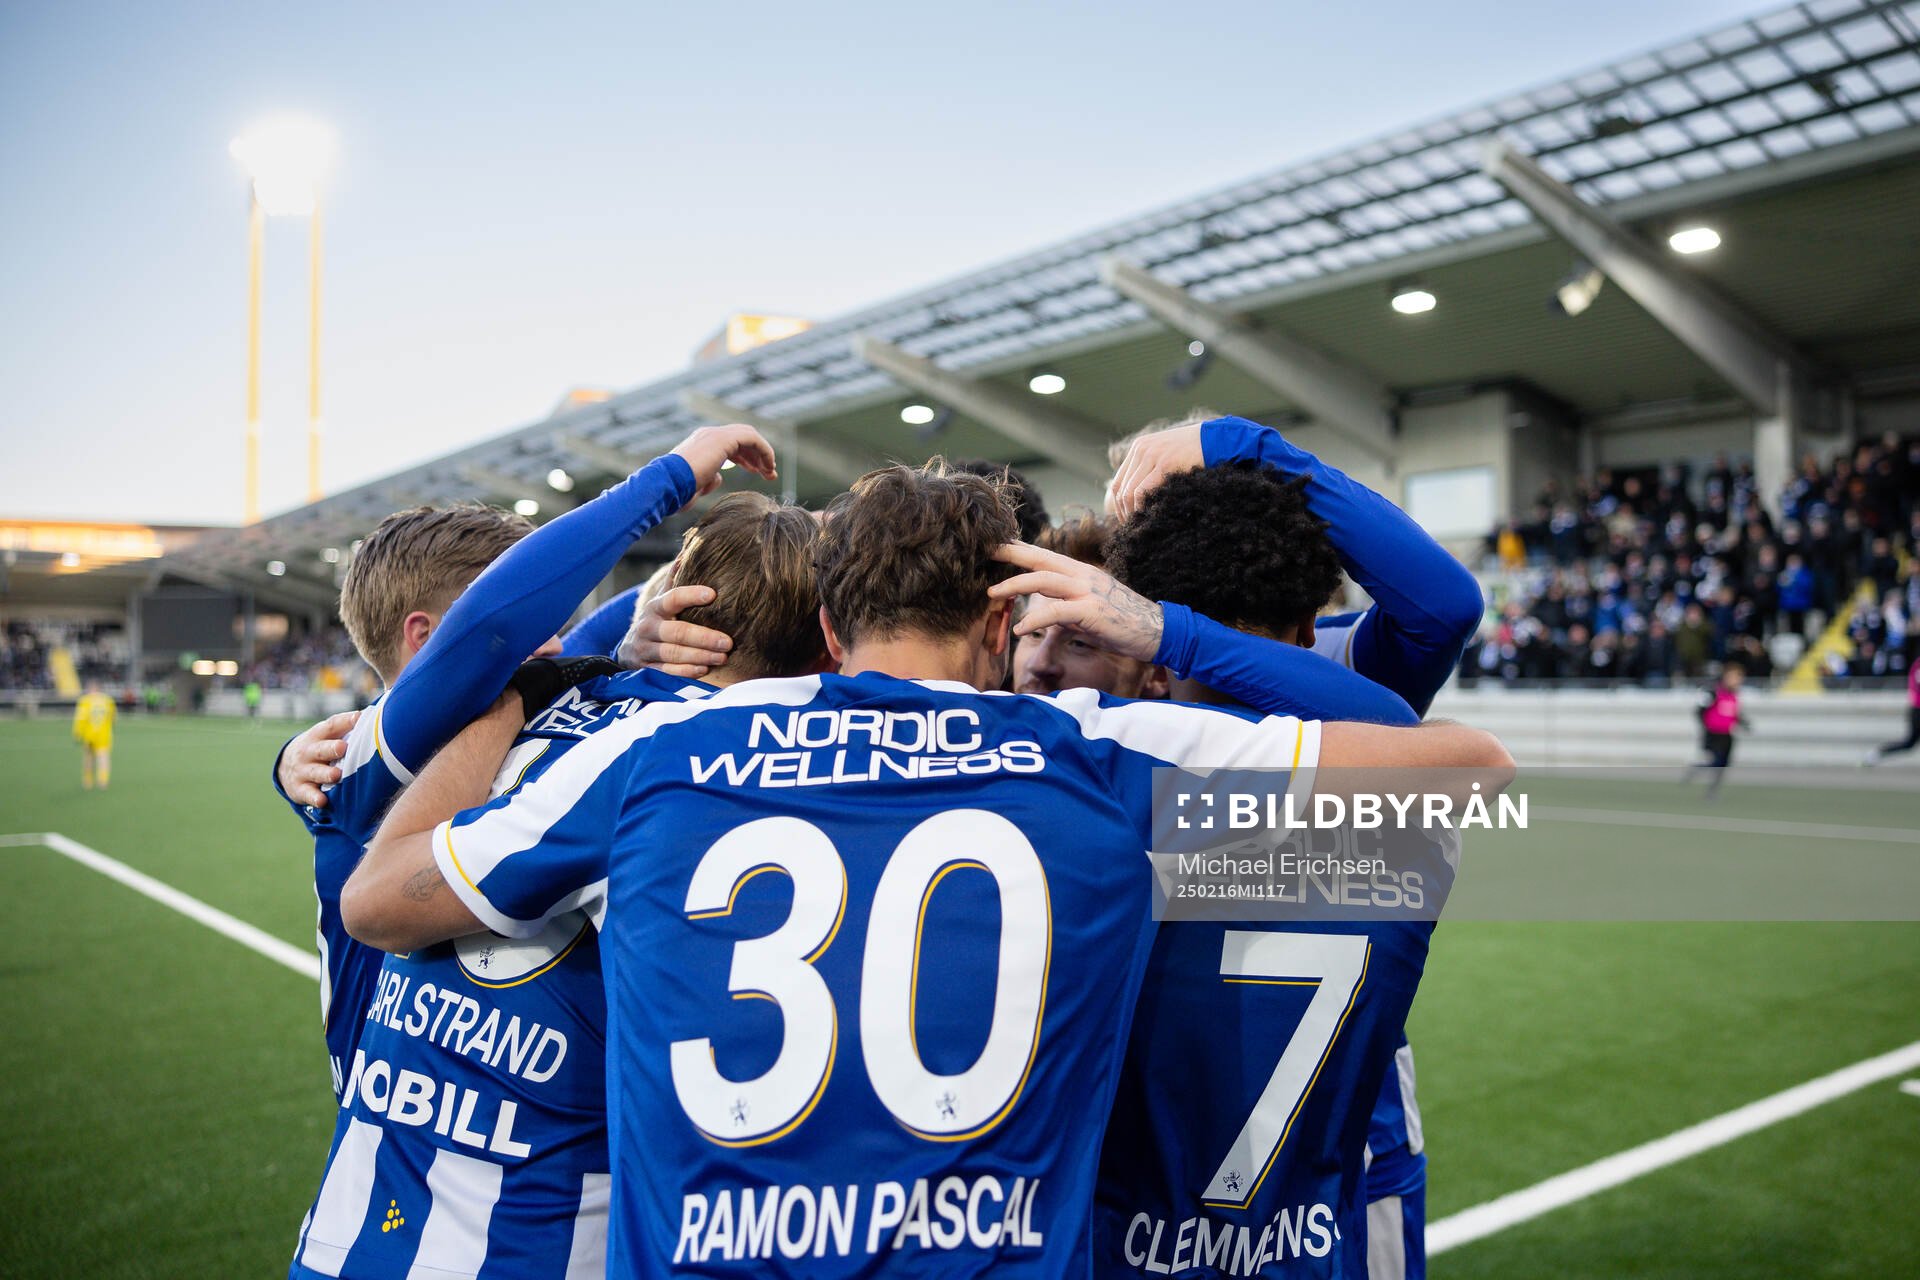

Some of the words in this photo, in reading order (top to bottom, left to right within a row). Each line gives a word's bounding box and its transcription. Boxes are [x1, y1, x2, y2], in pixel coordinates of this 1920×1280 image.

[689, 741, 1046, 788] WELLNESS
[748, 708, 982, 753] NORDIC
[670, 808, 1053, 1148] 30
[341, 1048, 532, 1158] MOBILL
[1200, 929, 1372, 1210] 7
[673, 1185, 859, 1264] RAMON
[866, 1175, 1043, 1254] PASCAL
